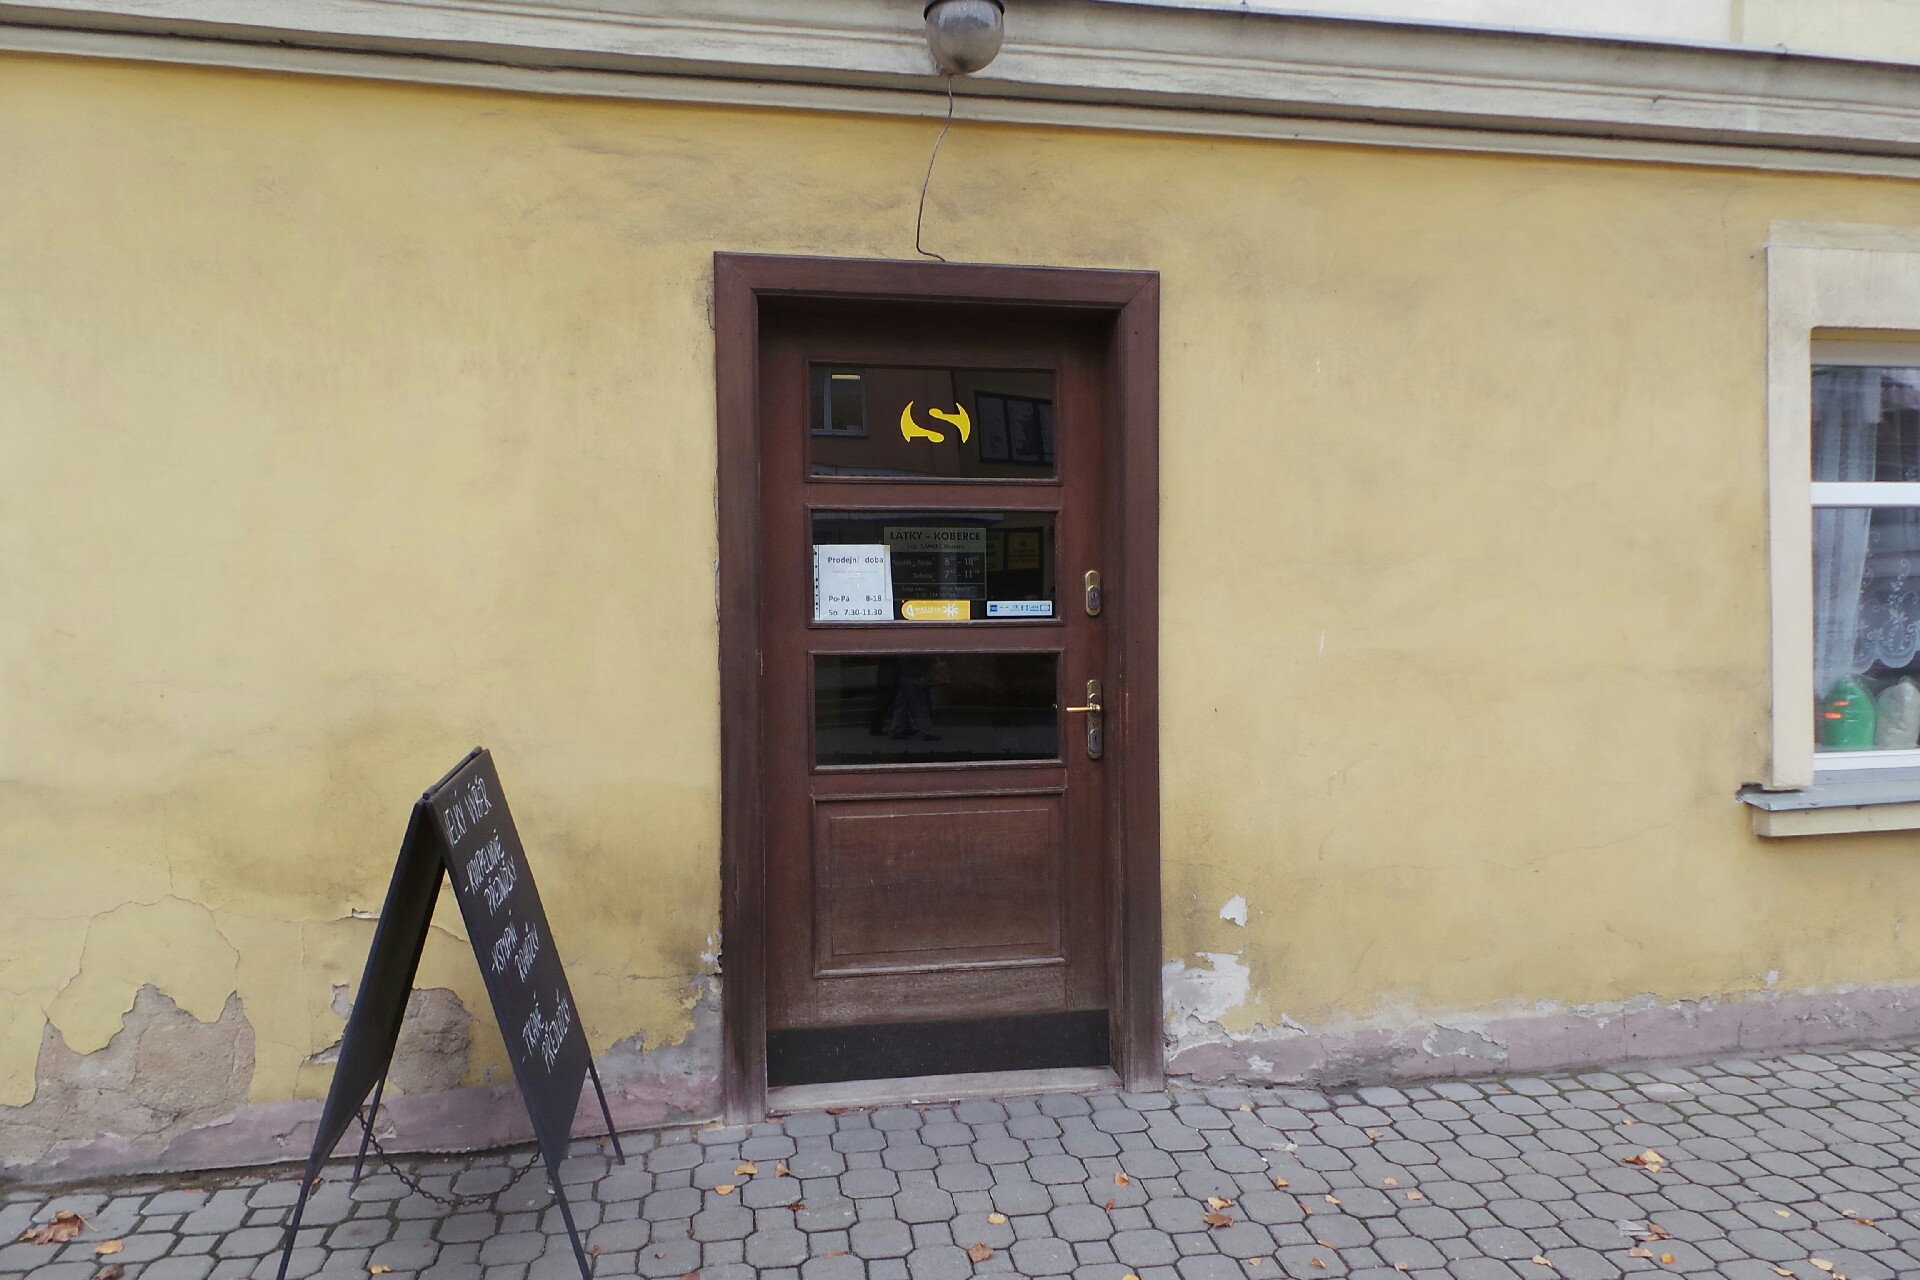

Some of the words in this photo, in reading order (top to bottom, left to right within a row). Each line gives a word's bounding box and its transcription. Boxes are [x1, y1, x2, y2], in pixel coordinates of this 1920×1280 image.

[890, 528, 923, 541] LÁTKY
[934, 531, 981, 541] KOBERCE
[827, 556, 860, 565] Prodejní
[864, 556, 884, 564] doba
[463, 774, 492, 825] VÝBĚR
